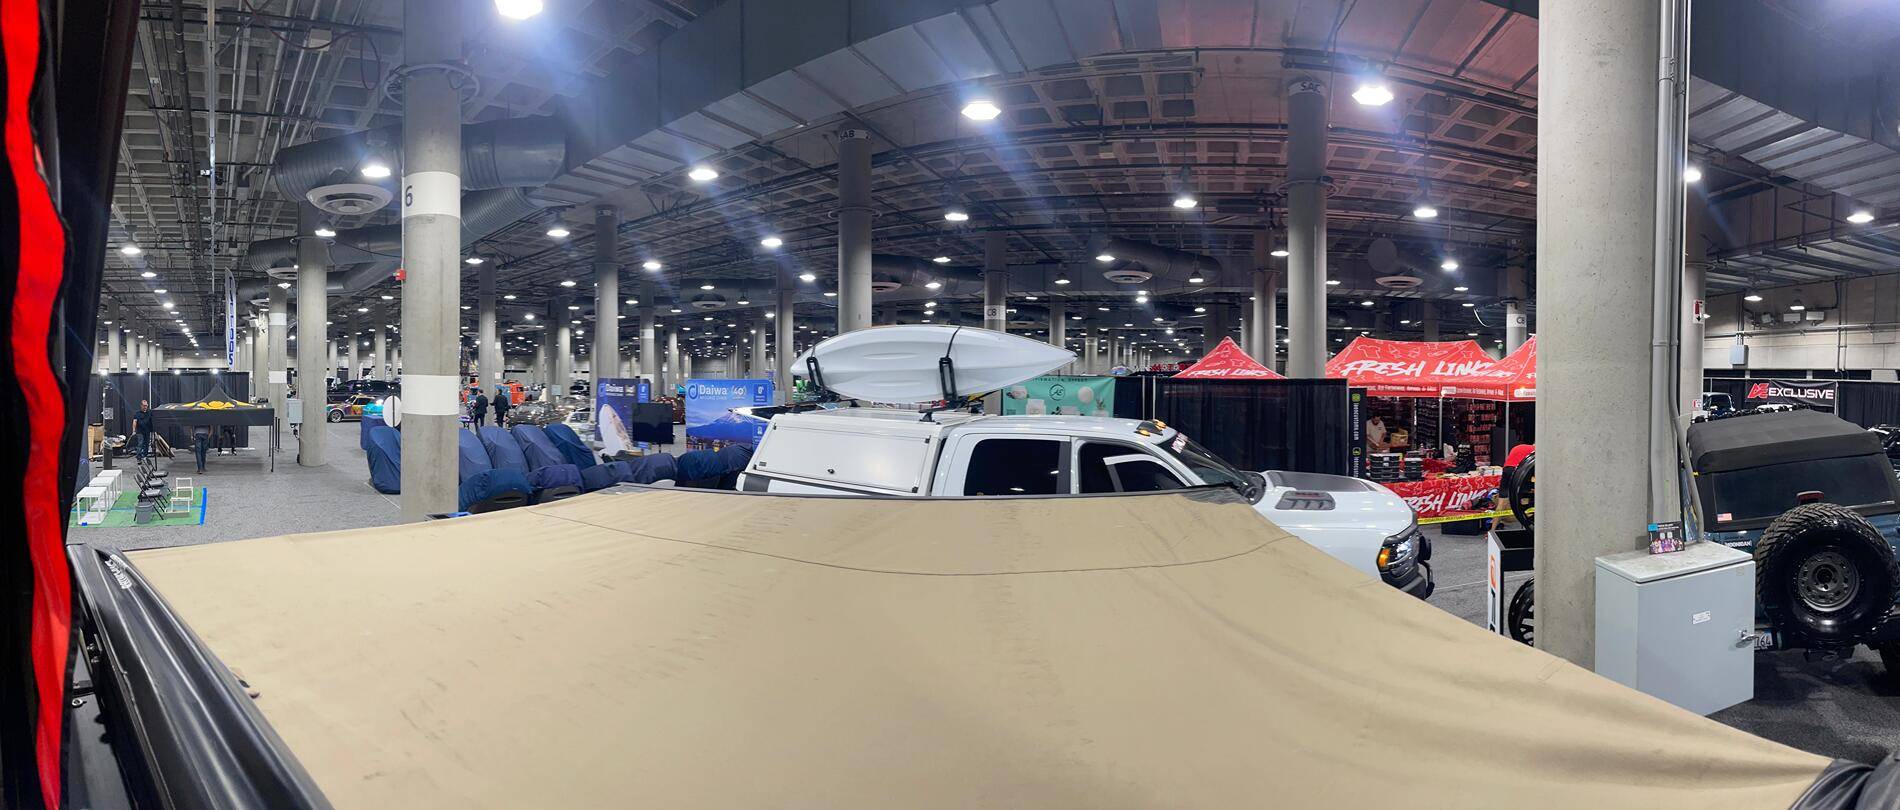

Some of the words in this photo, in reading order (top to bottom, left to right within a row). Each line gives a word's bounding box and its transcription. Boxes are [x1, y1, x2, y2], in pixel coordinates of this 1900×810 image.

[405, 185, 413, 207] 6
[987, 308, 997, 316] C8
[1340, 360, 1427, 377] FRESH
[700, 384, 727, 395] Daiwa
[1768, 387, 1834, 399] EXCLUSIVE
